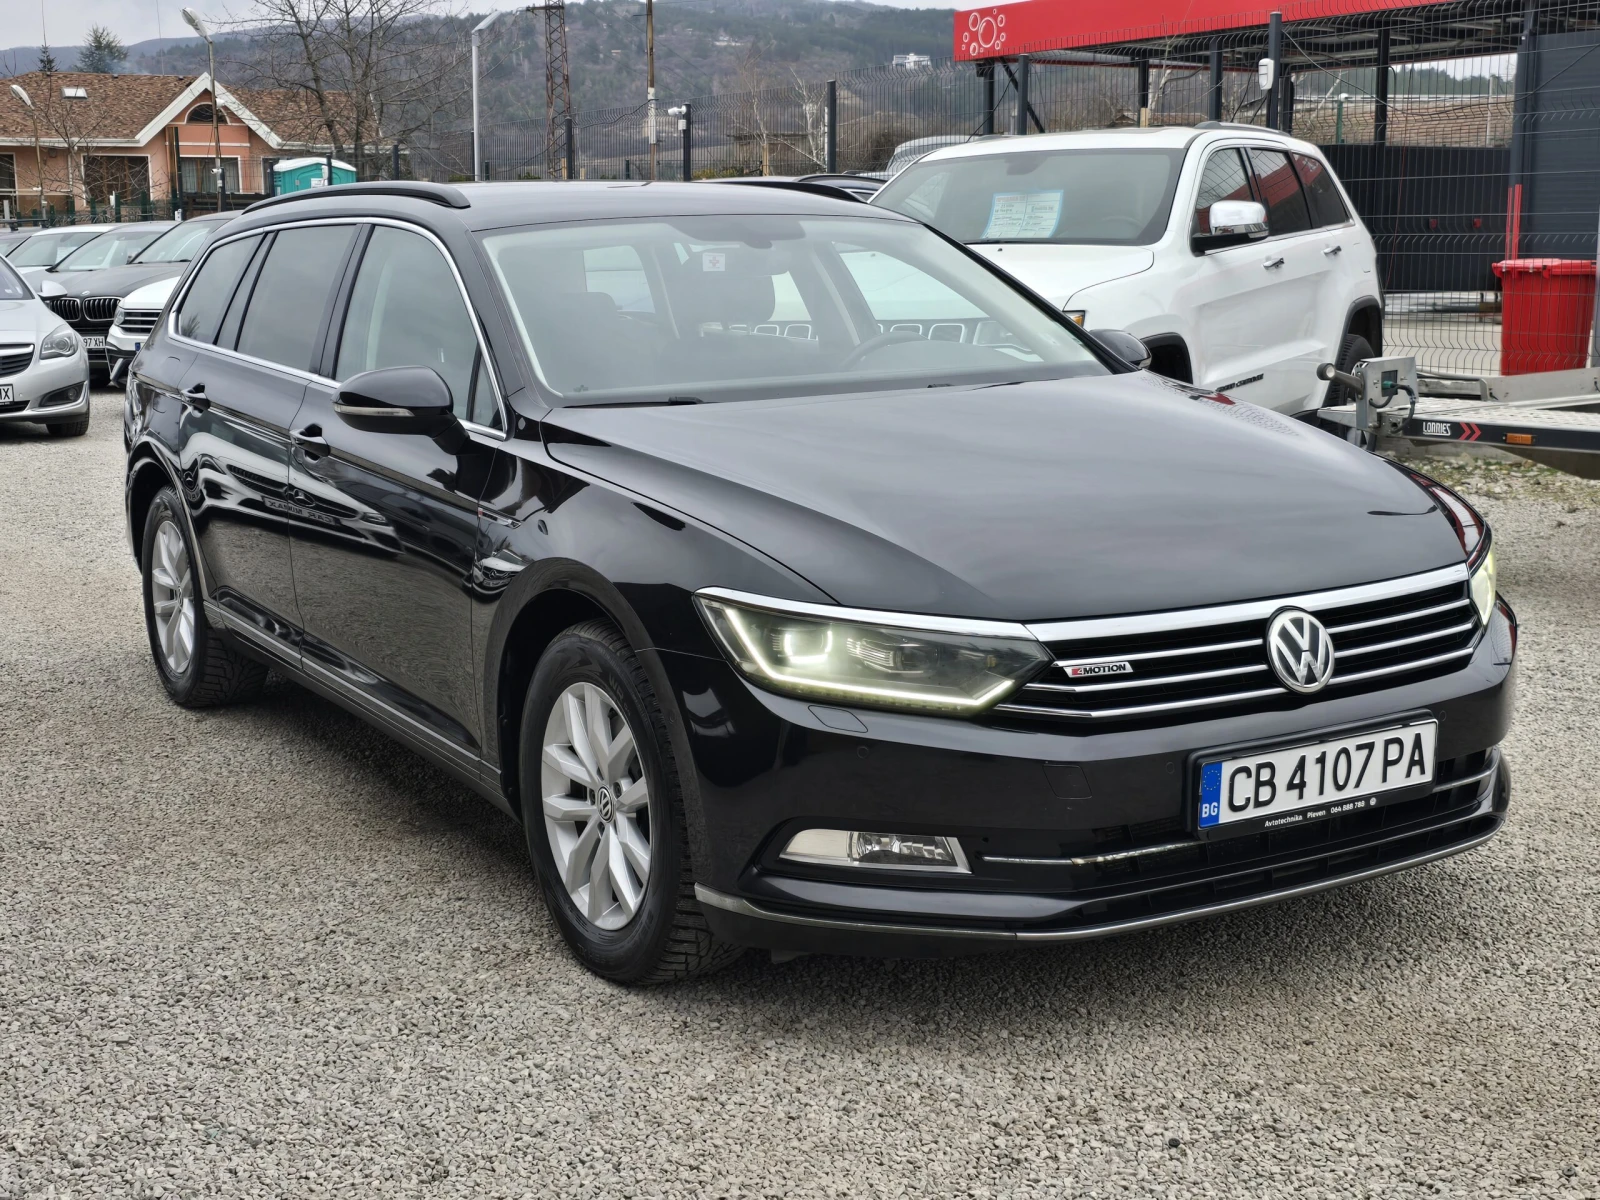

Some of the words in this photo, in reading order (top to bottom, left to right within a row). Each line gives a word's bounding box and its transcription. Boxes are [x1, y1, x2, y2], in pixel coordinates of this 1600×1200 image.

[93, 338, 104, 347] XH
[1423, 421, 1451, 436] LORRIES
[1227, 760, 1277, 813] CB
[1285, 740, 1376, 801] 4107
[1381, 732, 1426, 784] PA
[1202, 802, 1219, 818] BG
